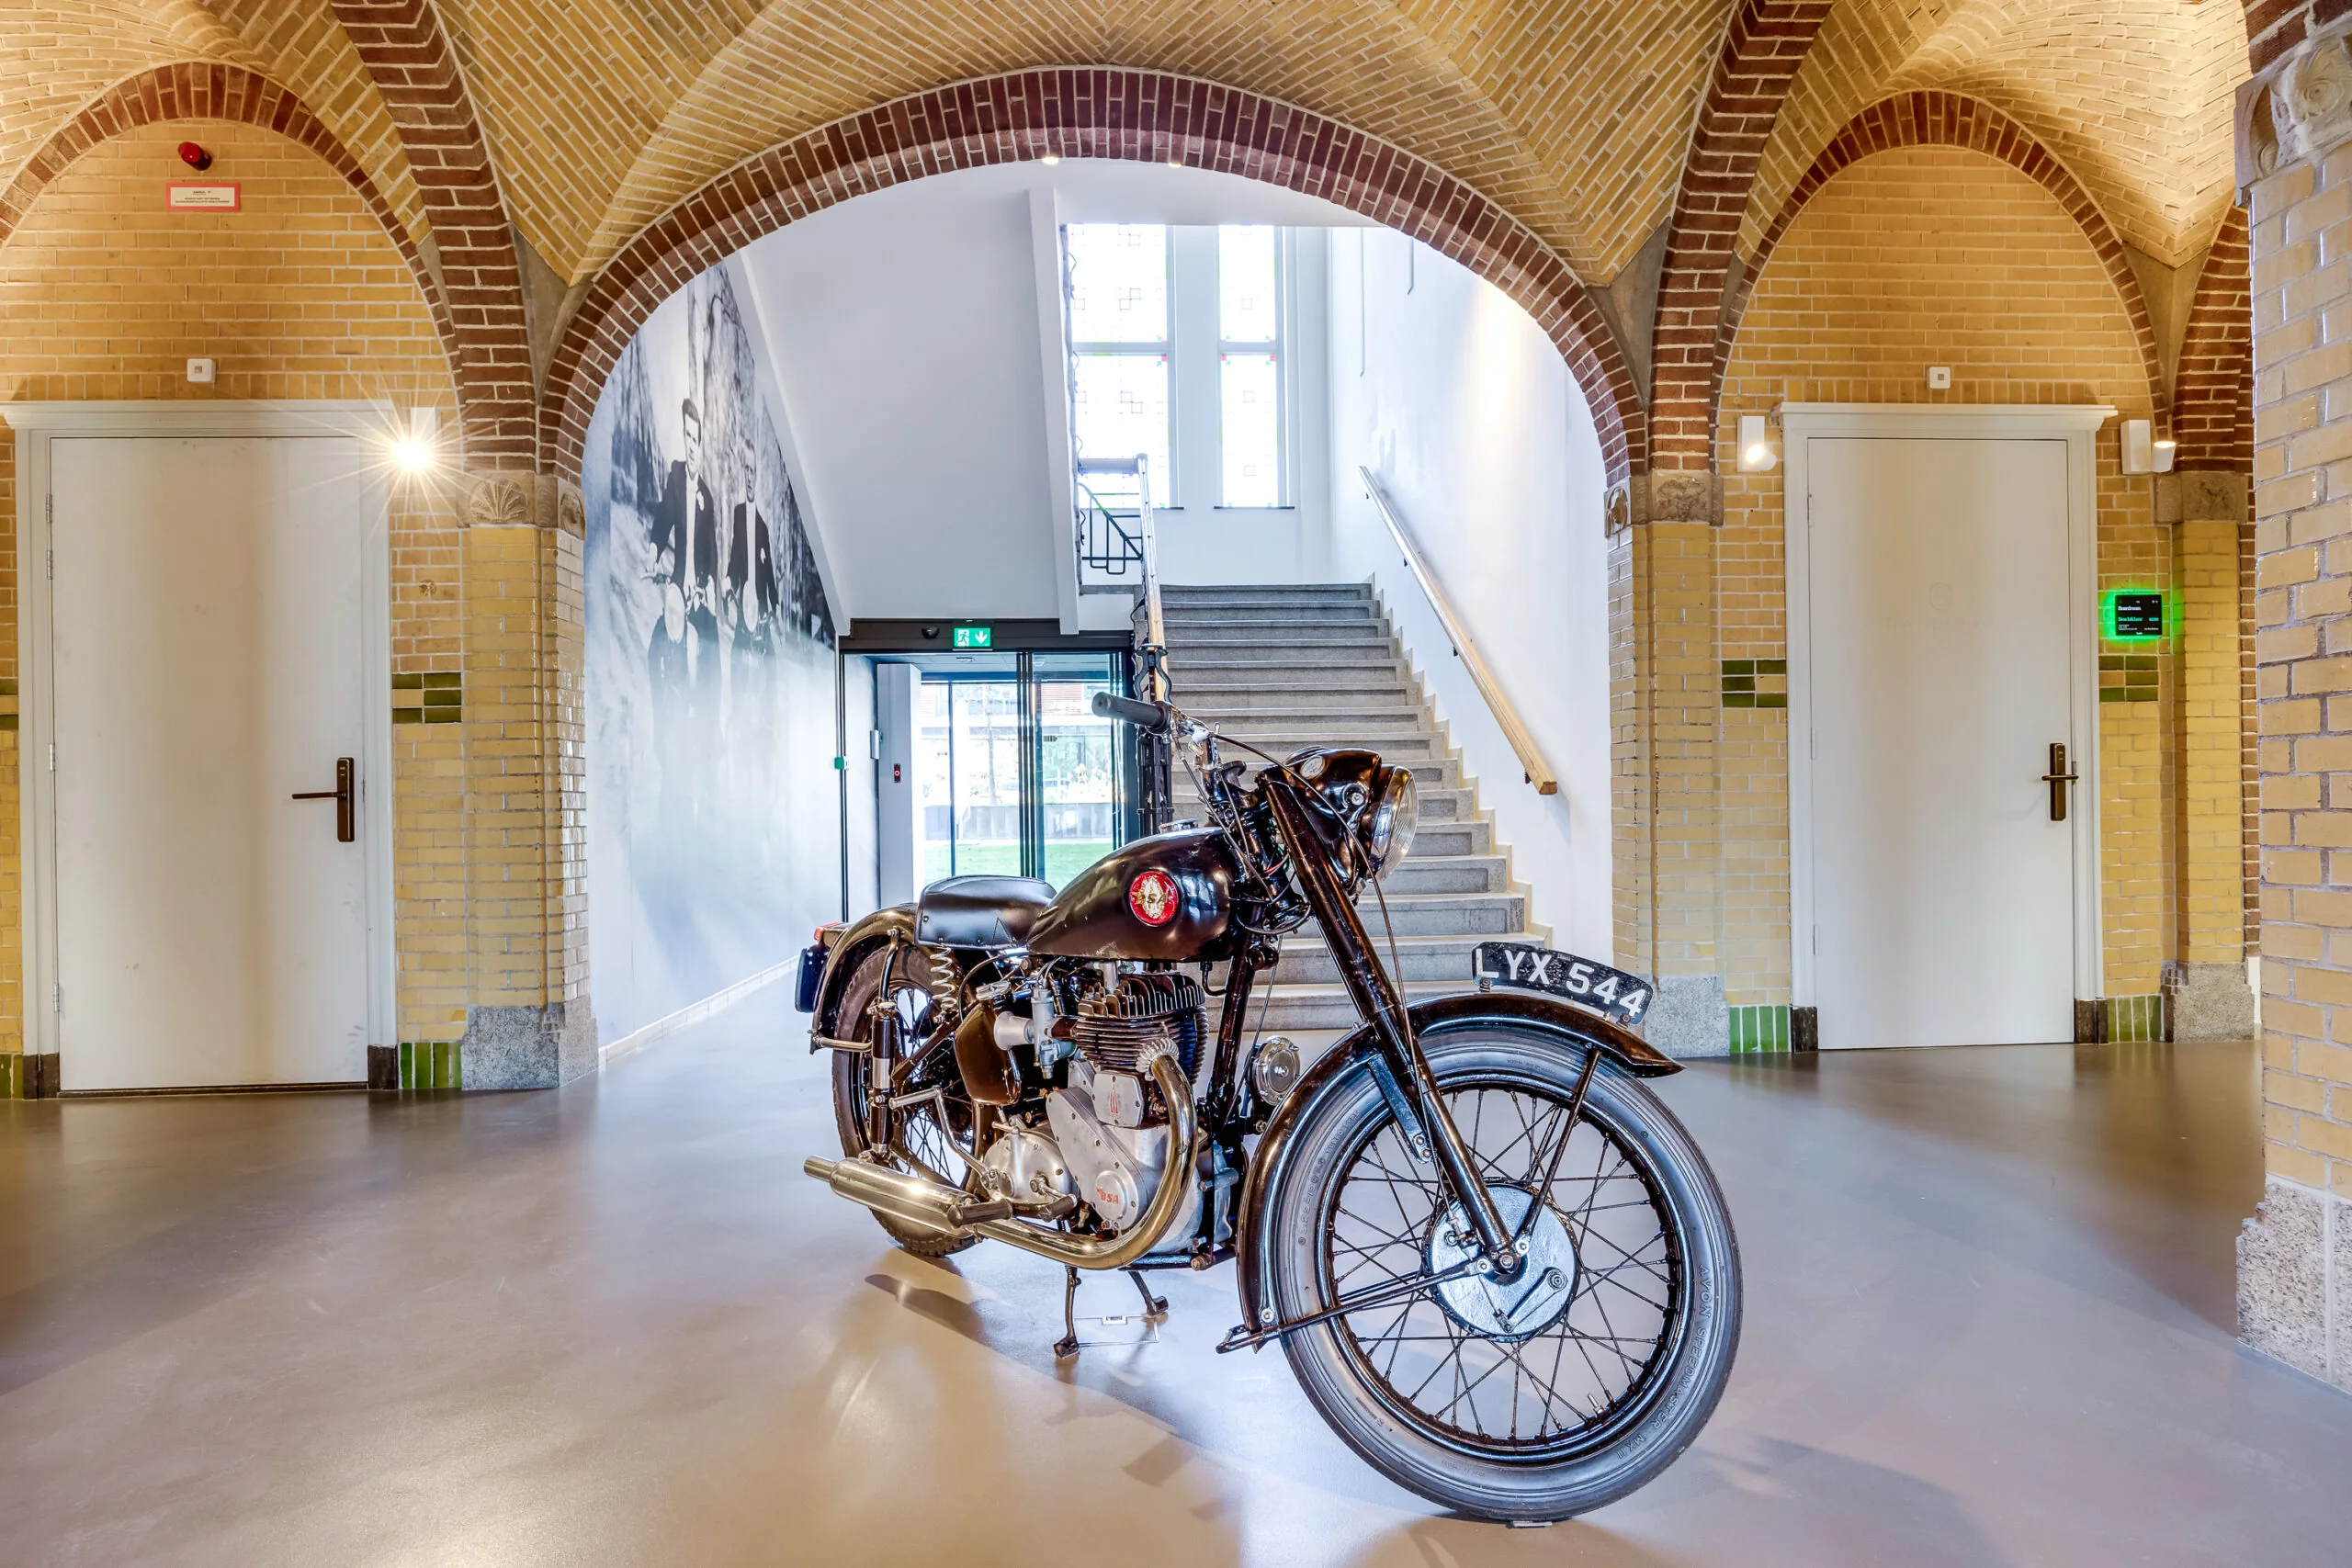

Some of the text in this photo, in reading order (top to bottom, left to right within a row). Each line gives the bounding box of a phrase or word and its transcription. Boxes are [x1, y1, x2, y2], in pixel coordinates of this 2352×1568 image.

[1476, 948, 1647, 1016] LYX 544
[1099, 1190, 1119, 1204] BSA
[1698, 1263, 1713, 1319] AVON
[1650, 1327, 1709, 1430] SPEEDMASTER
